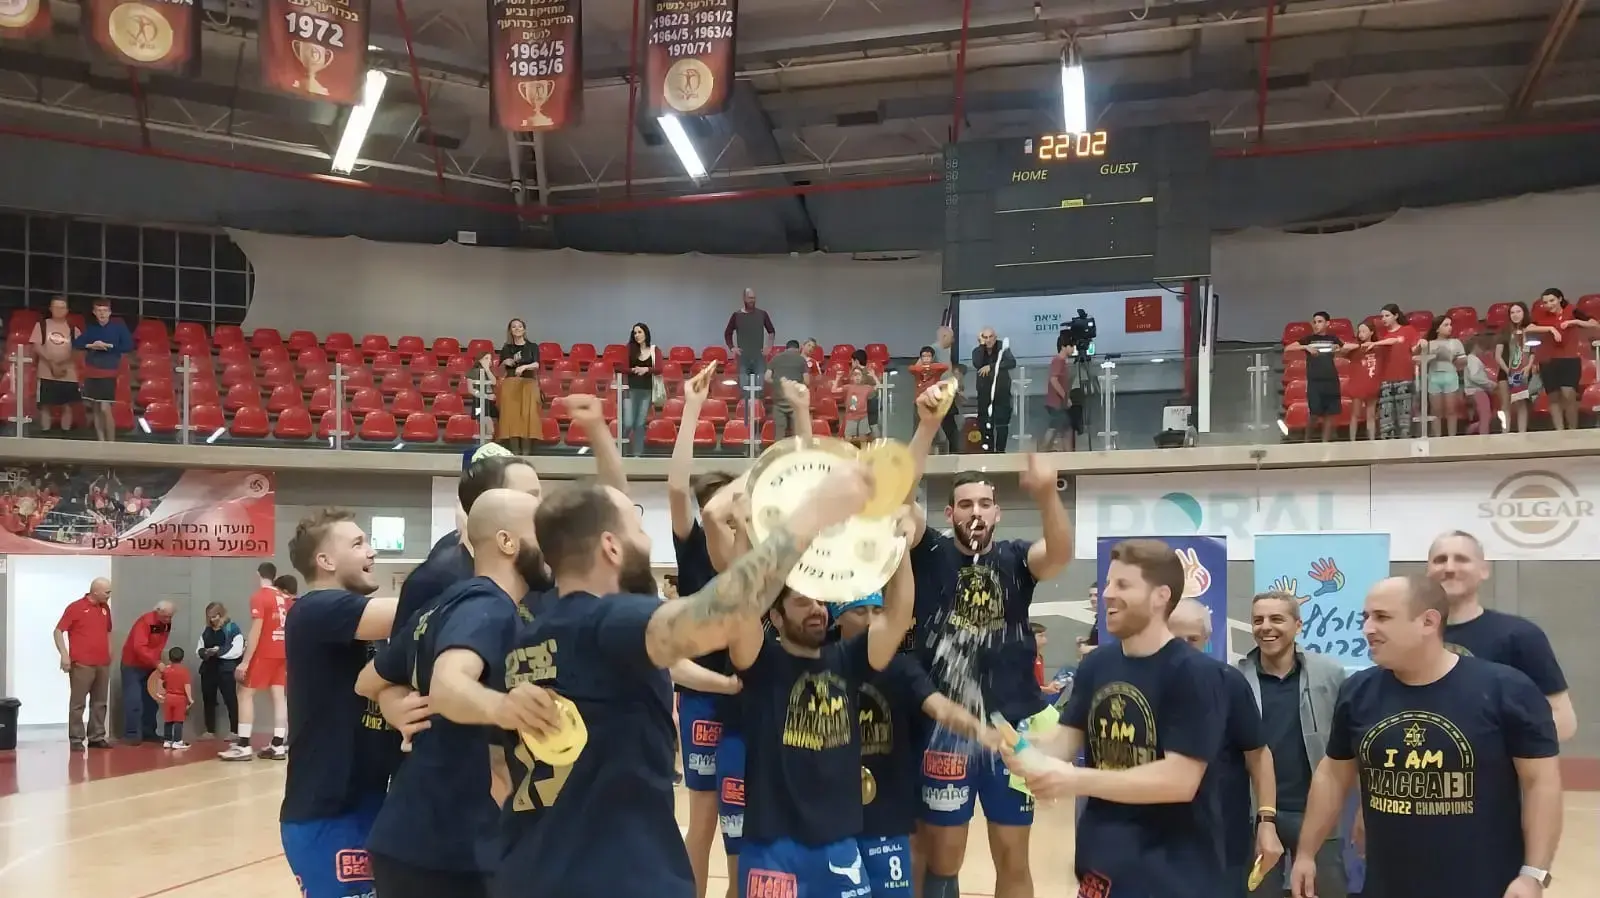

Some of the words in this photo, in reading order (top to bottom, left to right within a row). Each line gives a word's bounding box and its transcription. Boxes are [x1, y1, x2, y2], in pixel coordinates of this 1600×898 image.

[285, 12, 344, 48] 1972
[668, 41, 713, 57] 1970/71
[510, 58, 564, 77] 1965/6
[1012, 169, 1049, 182] HOME
[1100, 162, 1139, 175] GUEST
[1478, 500, 1595, 519] SOLGAR
[148, 522, 208, 536] הכדורעף
[214, 523, 255, 536] מועדון
[91, 537, 119, 550] עכו
[126, 537, 165, 550] אשר
[172, 538, 210, 551] מטה
[217, 537, 268, 552] הפועל
[1099, 718, 1107, 739] I
[1110, 719, 1136, 744] AM
[1383, 748, 1399, 768] I
[1405, 749, 1444, 769] AM
[1415, 801, 1475, 816] CHAMPIONS
[889, 855, 903, 881] 8
